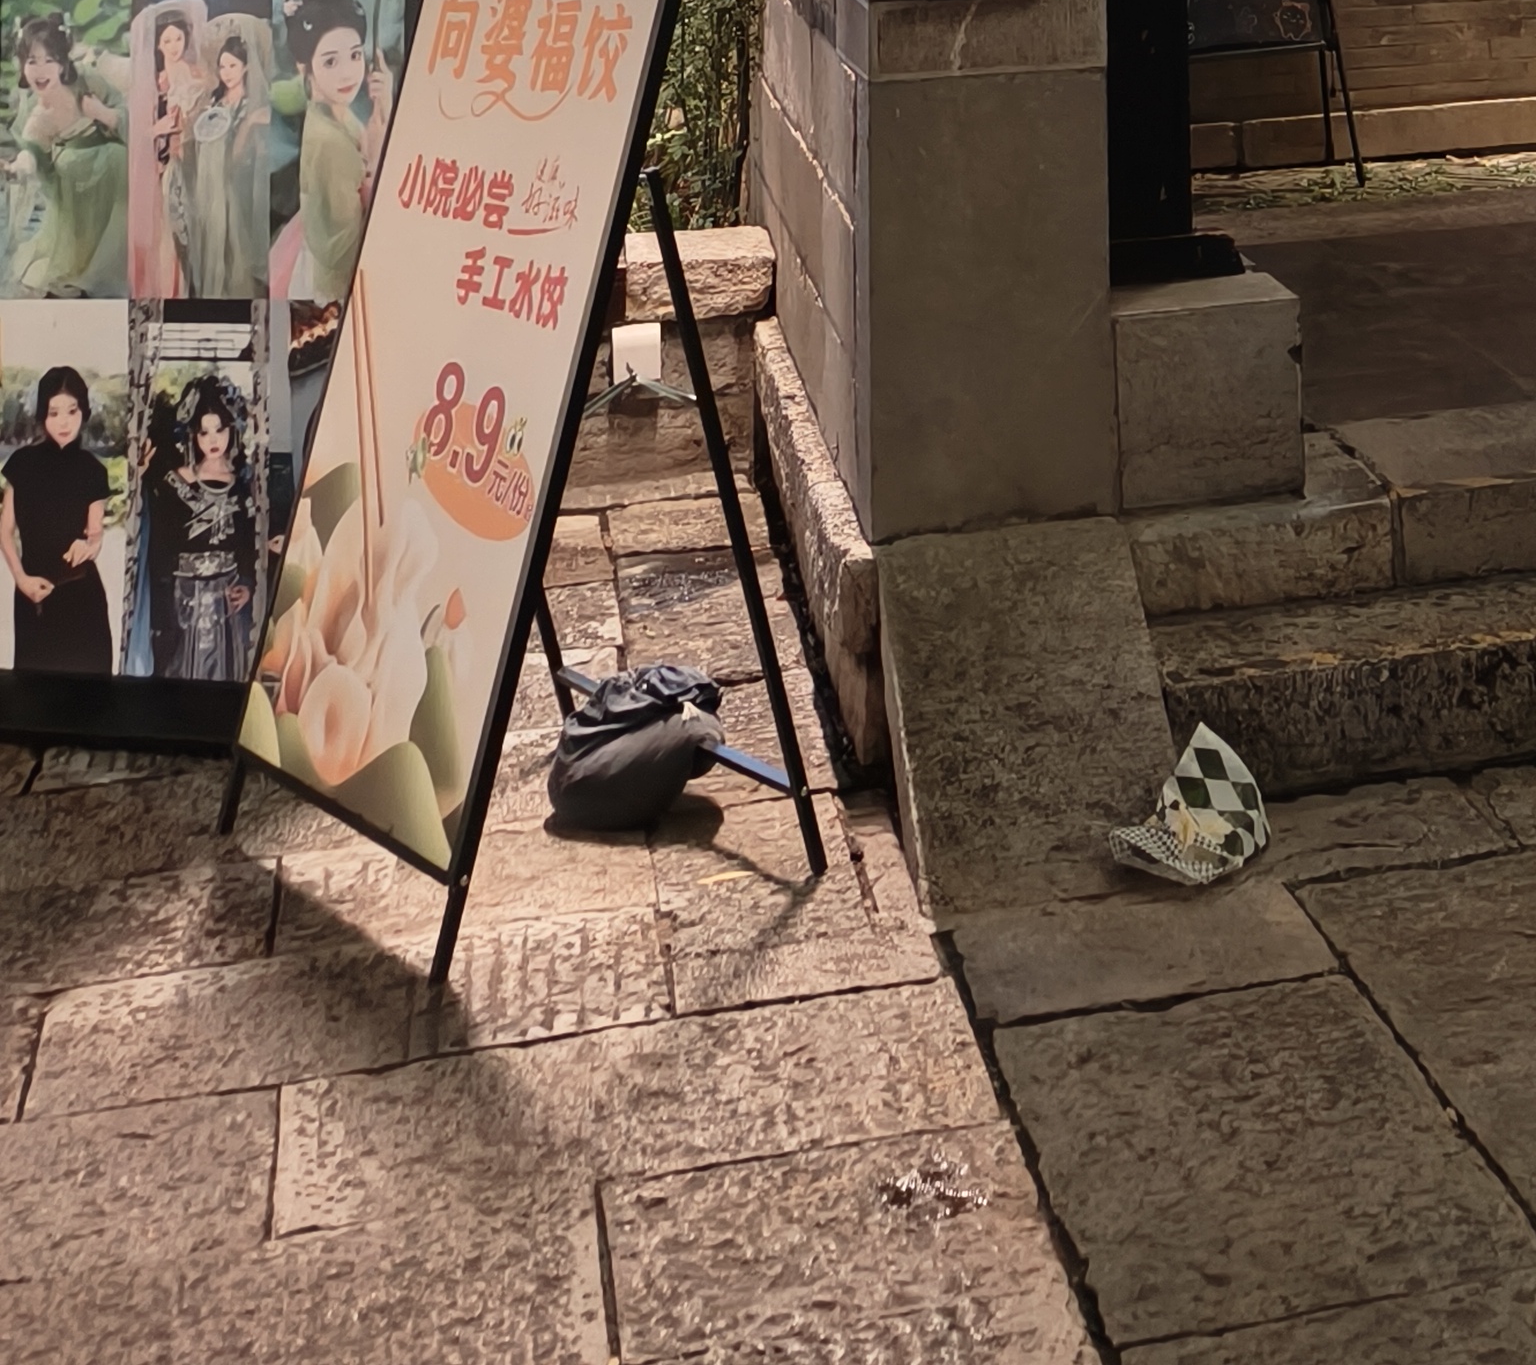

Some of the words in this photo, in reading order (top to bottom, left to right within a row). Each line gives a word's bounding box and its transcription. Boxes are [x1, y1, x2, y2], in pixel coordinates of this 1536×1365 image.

[397, 153, 515, 232] 小院必尝
[456, 245, 568, 332] 手工水饺
